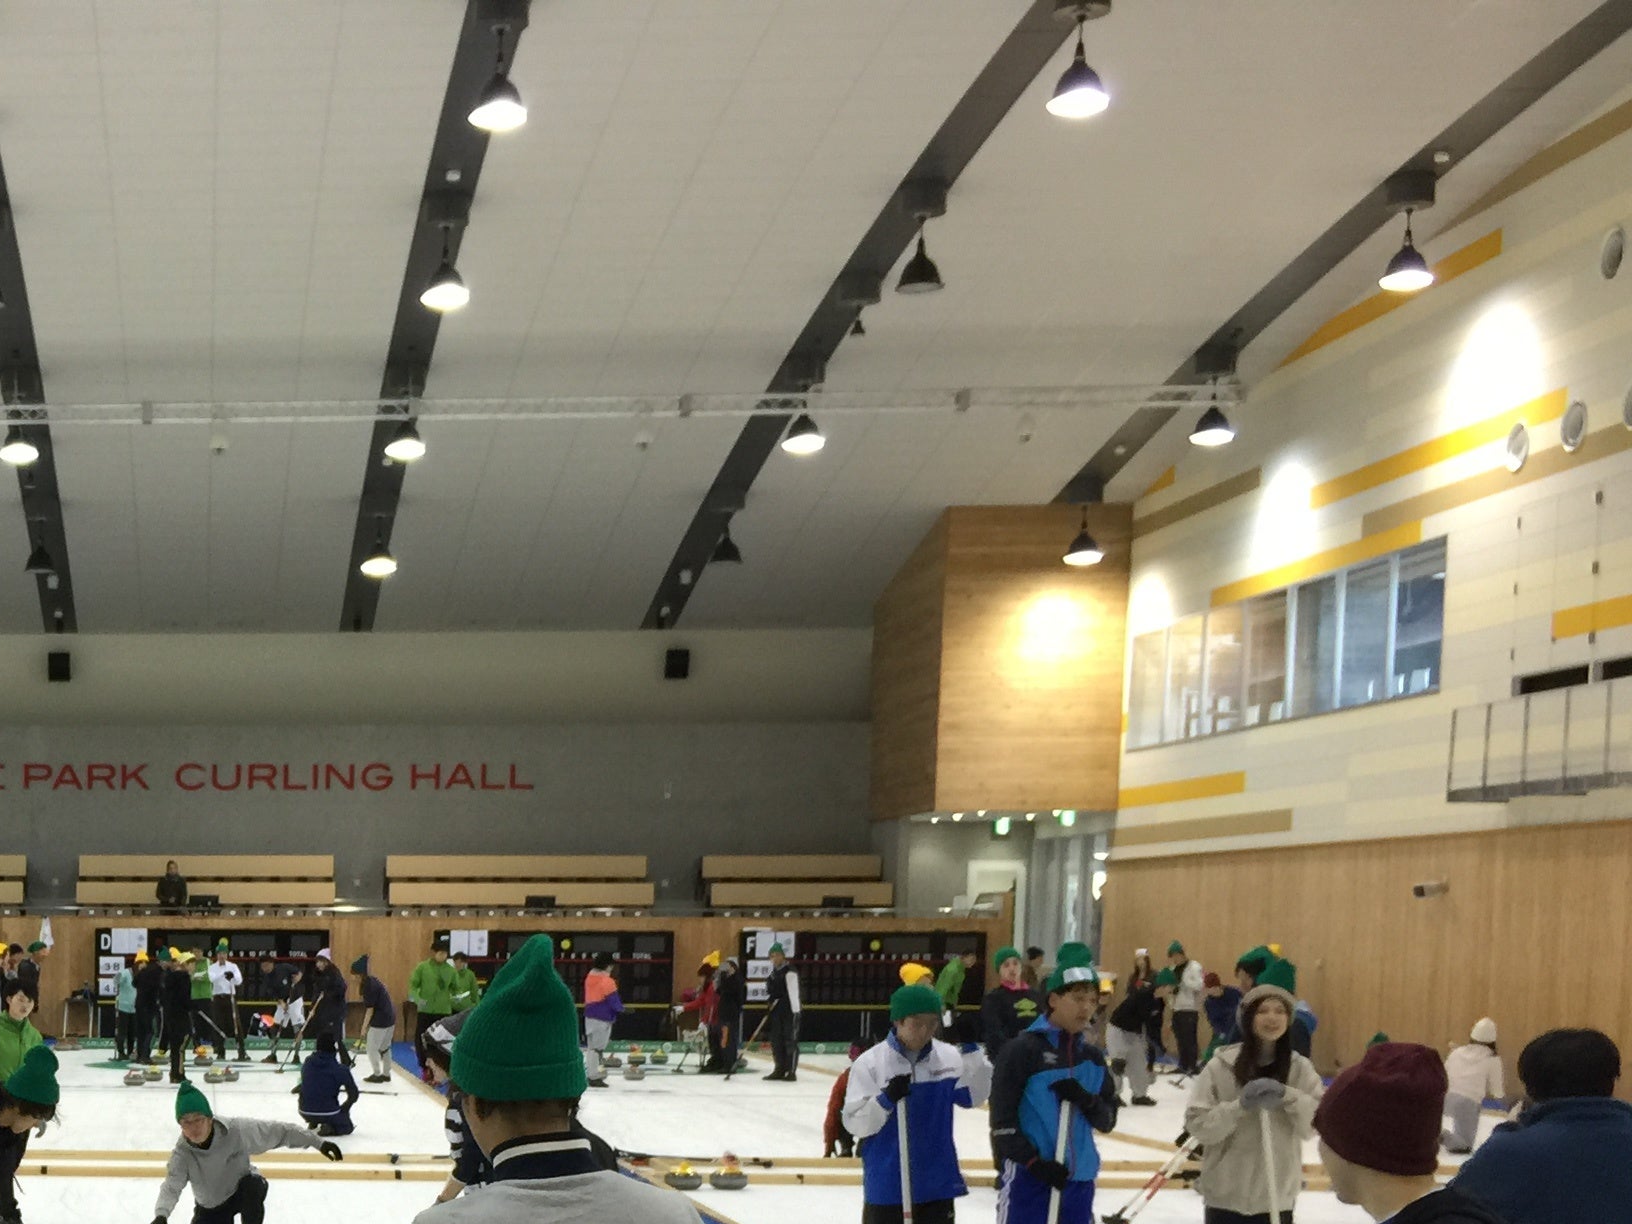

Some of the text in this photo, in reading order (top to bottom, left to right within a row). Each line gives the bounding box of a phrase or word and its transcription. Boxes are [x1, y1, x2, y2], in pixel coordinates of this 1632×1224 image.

[22, 763, 150, 790] PARK
[175, 763, 394, 791] CURLING
[410, 763, 535, 790] HALL
[100, 934, 112, 951] D
